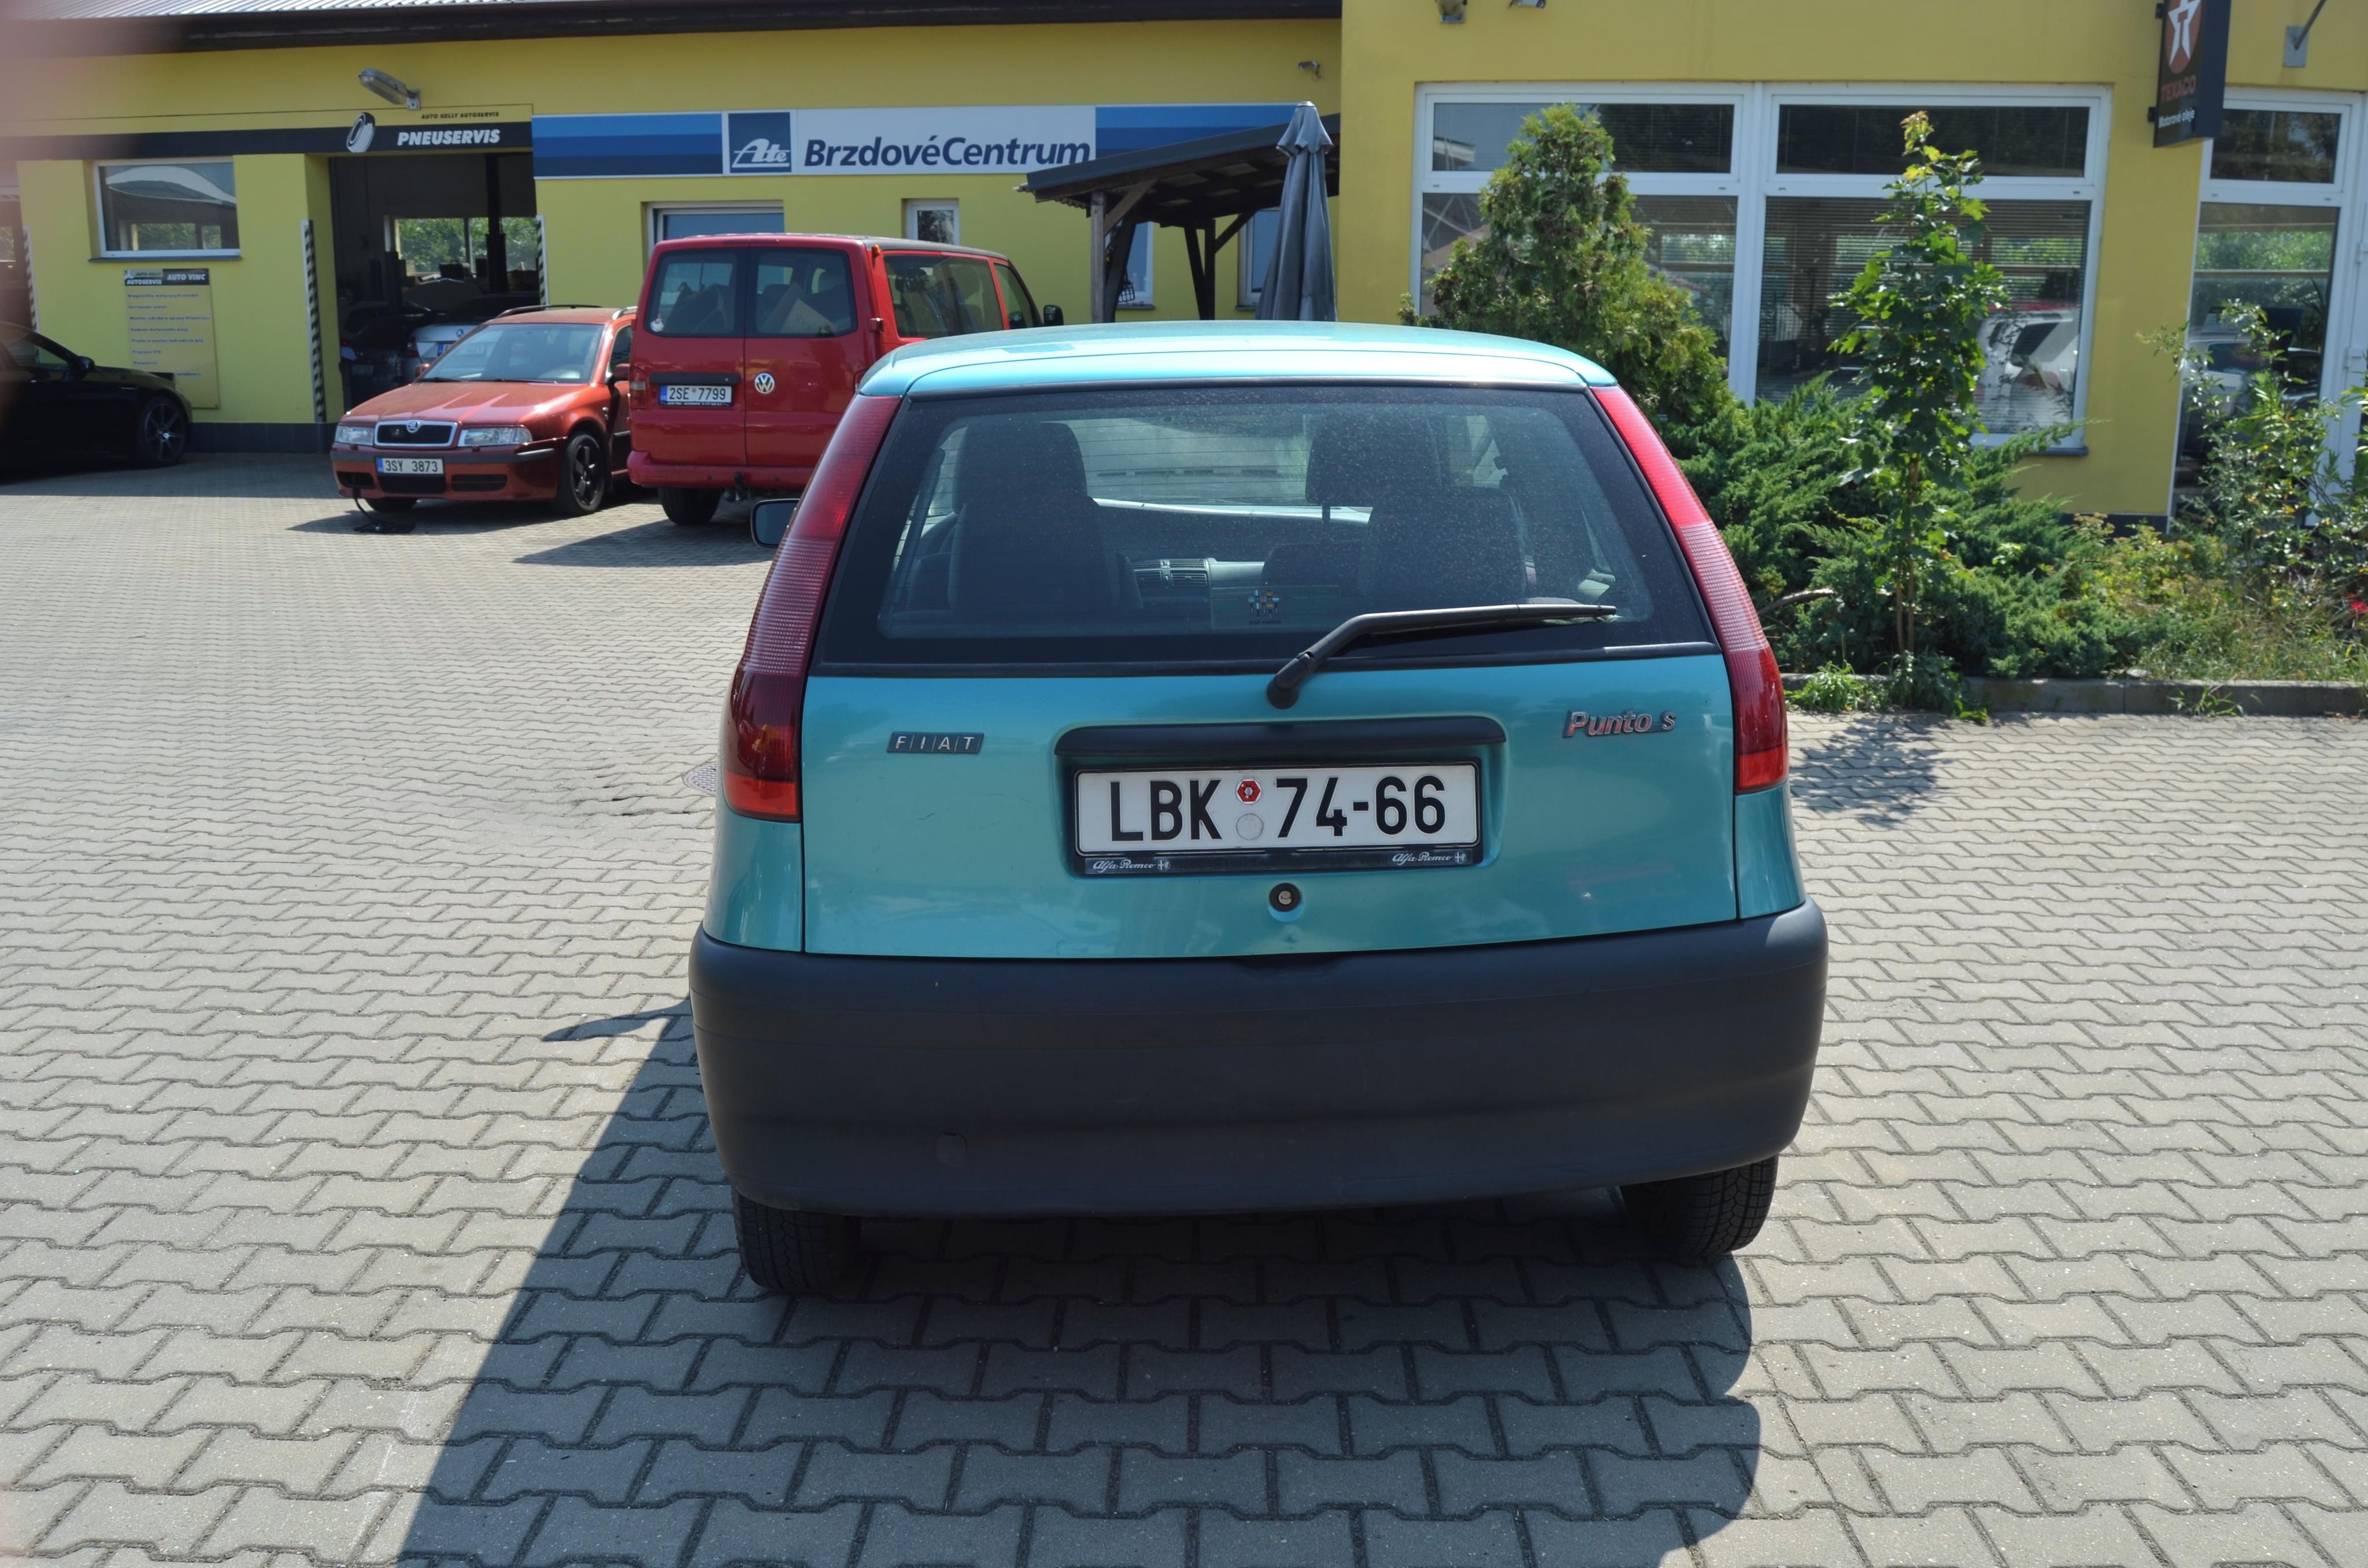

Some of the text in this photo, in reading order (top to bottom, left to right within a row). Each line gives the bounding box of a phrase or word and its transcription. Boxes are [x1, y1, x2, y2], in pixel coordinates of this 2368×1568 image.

[2161, 75, 2196, 102] TEXACO
[397, 129, 500, 146] PNEUSERVIS
[804, 135, 1091, 167] BrzdovéCentrum
[669, 387, 726, 400] 2SE 7799
[385, 460, 438, 472] 3SY 3873
[1566, 710, 1652, 736] Punto
[894, 736, 975, 750] FIAT
[1109, 774, 1446, 842] LBK 74-66
[1392, 852, 1416, 865] Alfa
[1418, 851, 1453, 861] Romeo
[1093, 859, 1156, 873] Alfa Romeo
